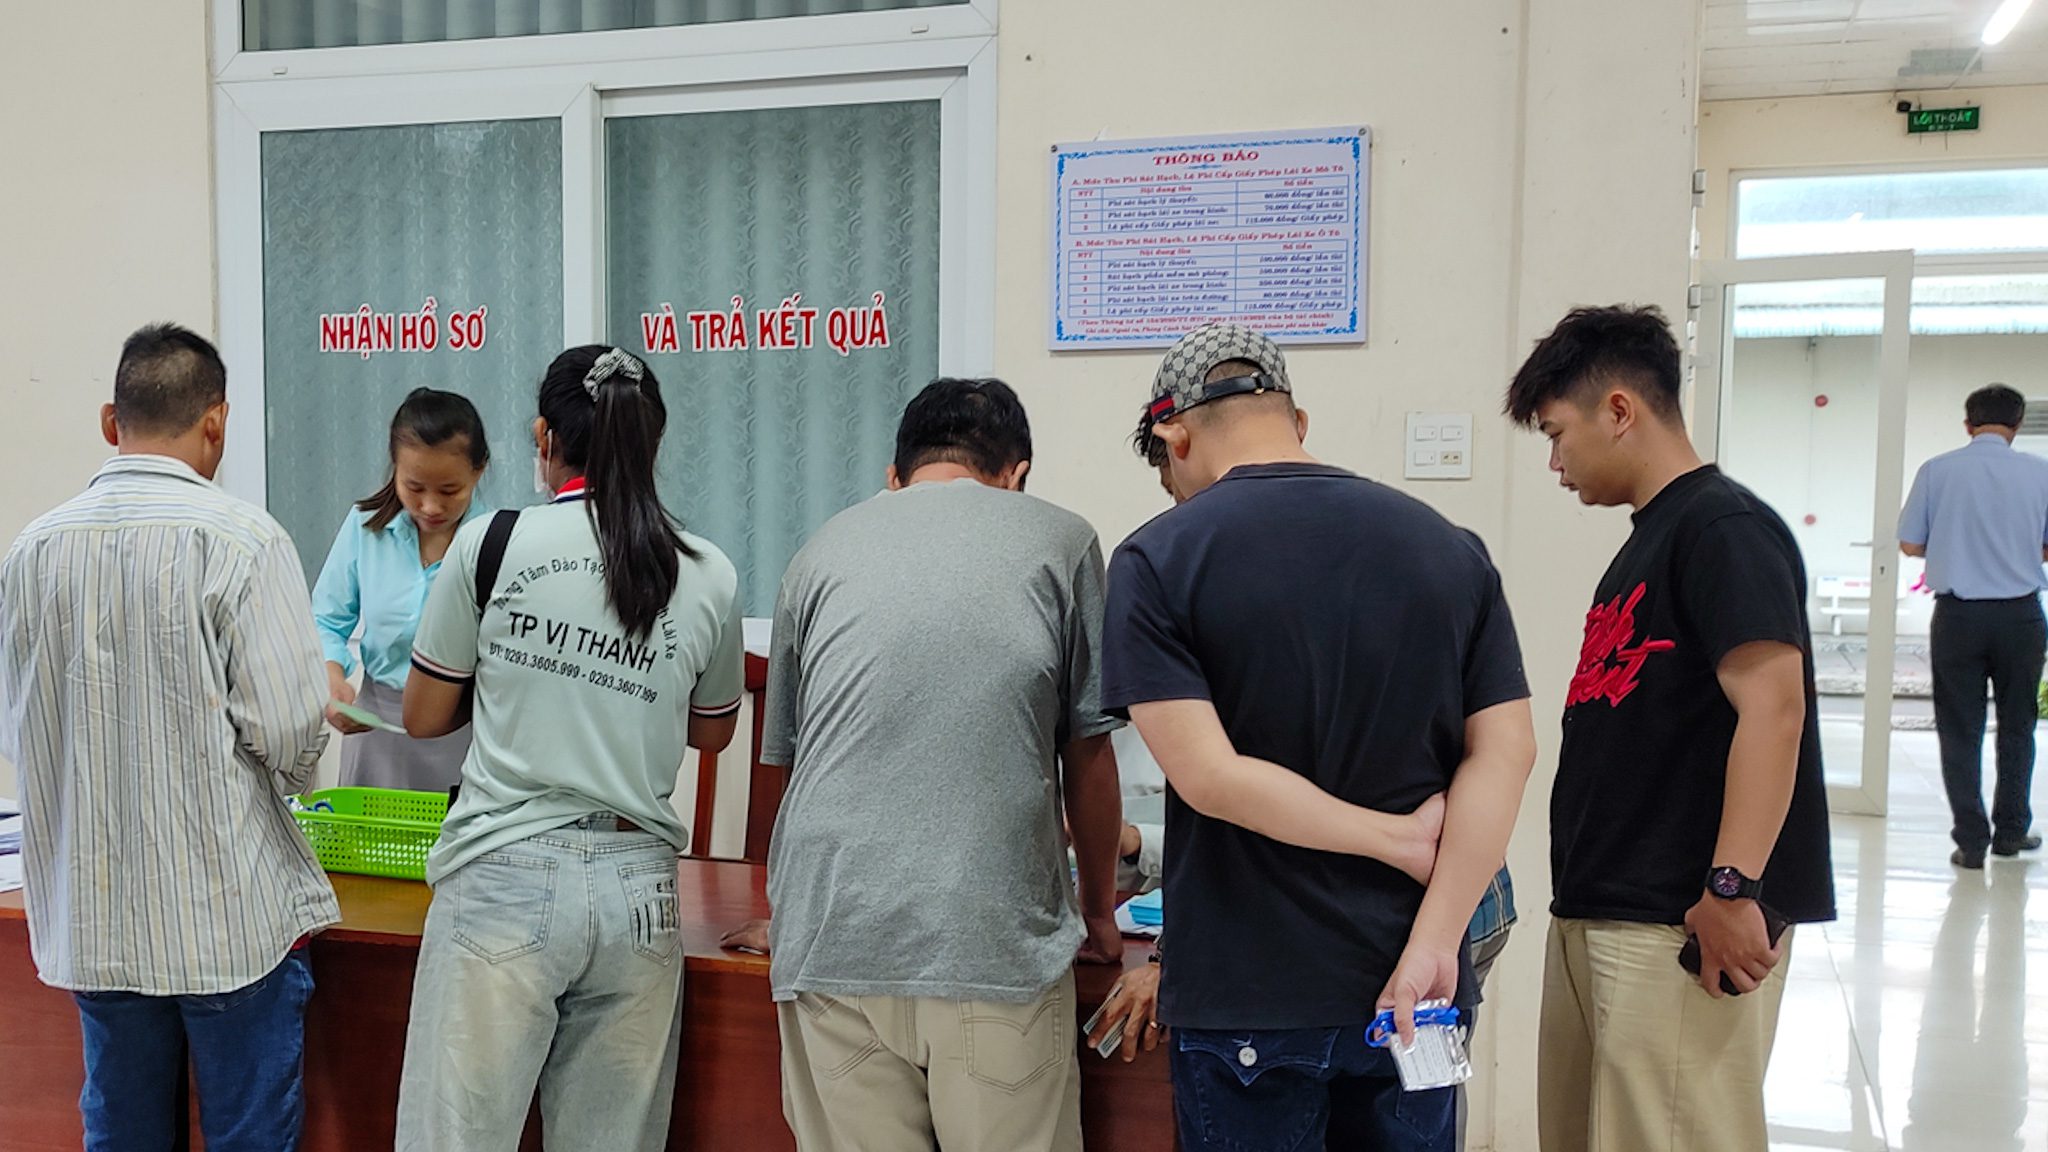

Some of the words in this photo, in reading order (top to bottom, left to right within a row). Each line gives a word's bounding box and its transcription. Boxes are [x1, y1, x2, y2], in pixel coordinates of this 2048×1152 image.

[1153, 152, 1215, 166] THÔNG
[1223, 150, 1259, 162] BÁO
[321, 304, 394, 359] NHẬN
[400, 296, 438, 352] HỒ
[448, 305, 488, 352] SƠ
[642, 303, 680, 353] VÀ
[688, 295, 748, 351] TRẢ
[757, 292, 819, 350] KẾT
[826, 290, 890, 356] QUẢ
[518, 566, 550, 585] Tâm
[552, 558, 578, 573] Đào
[508, 611, 538, 639] TP
[546, 619, 570, 655] VỊ
[576, 627, 657, 674] THANH
